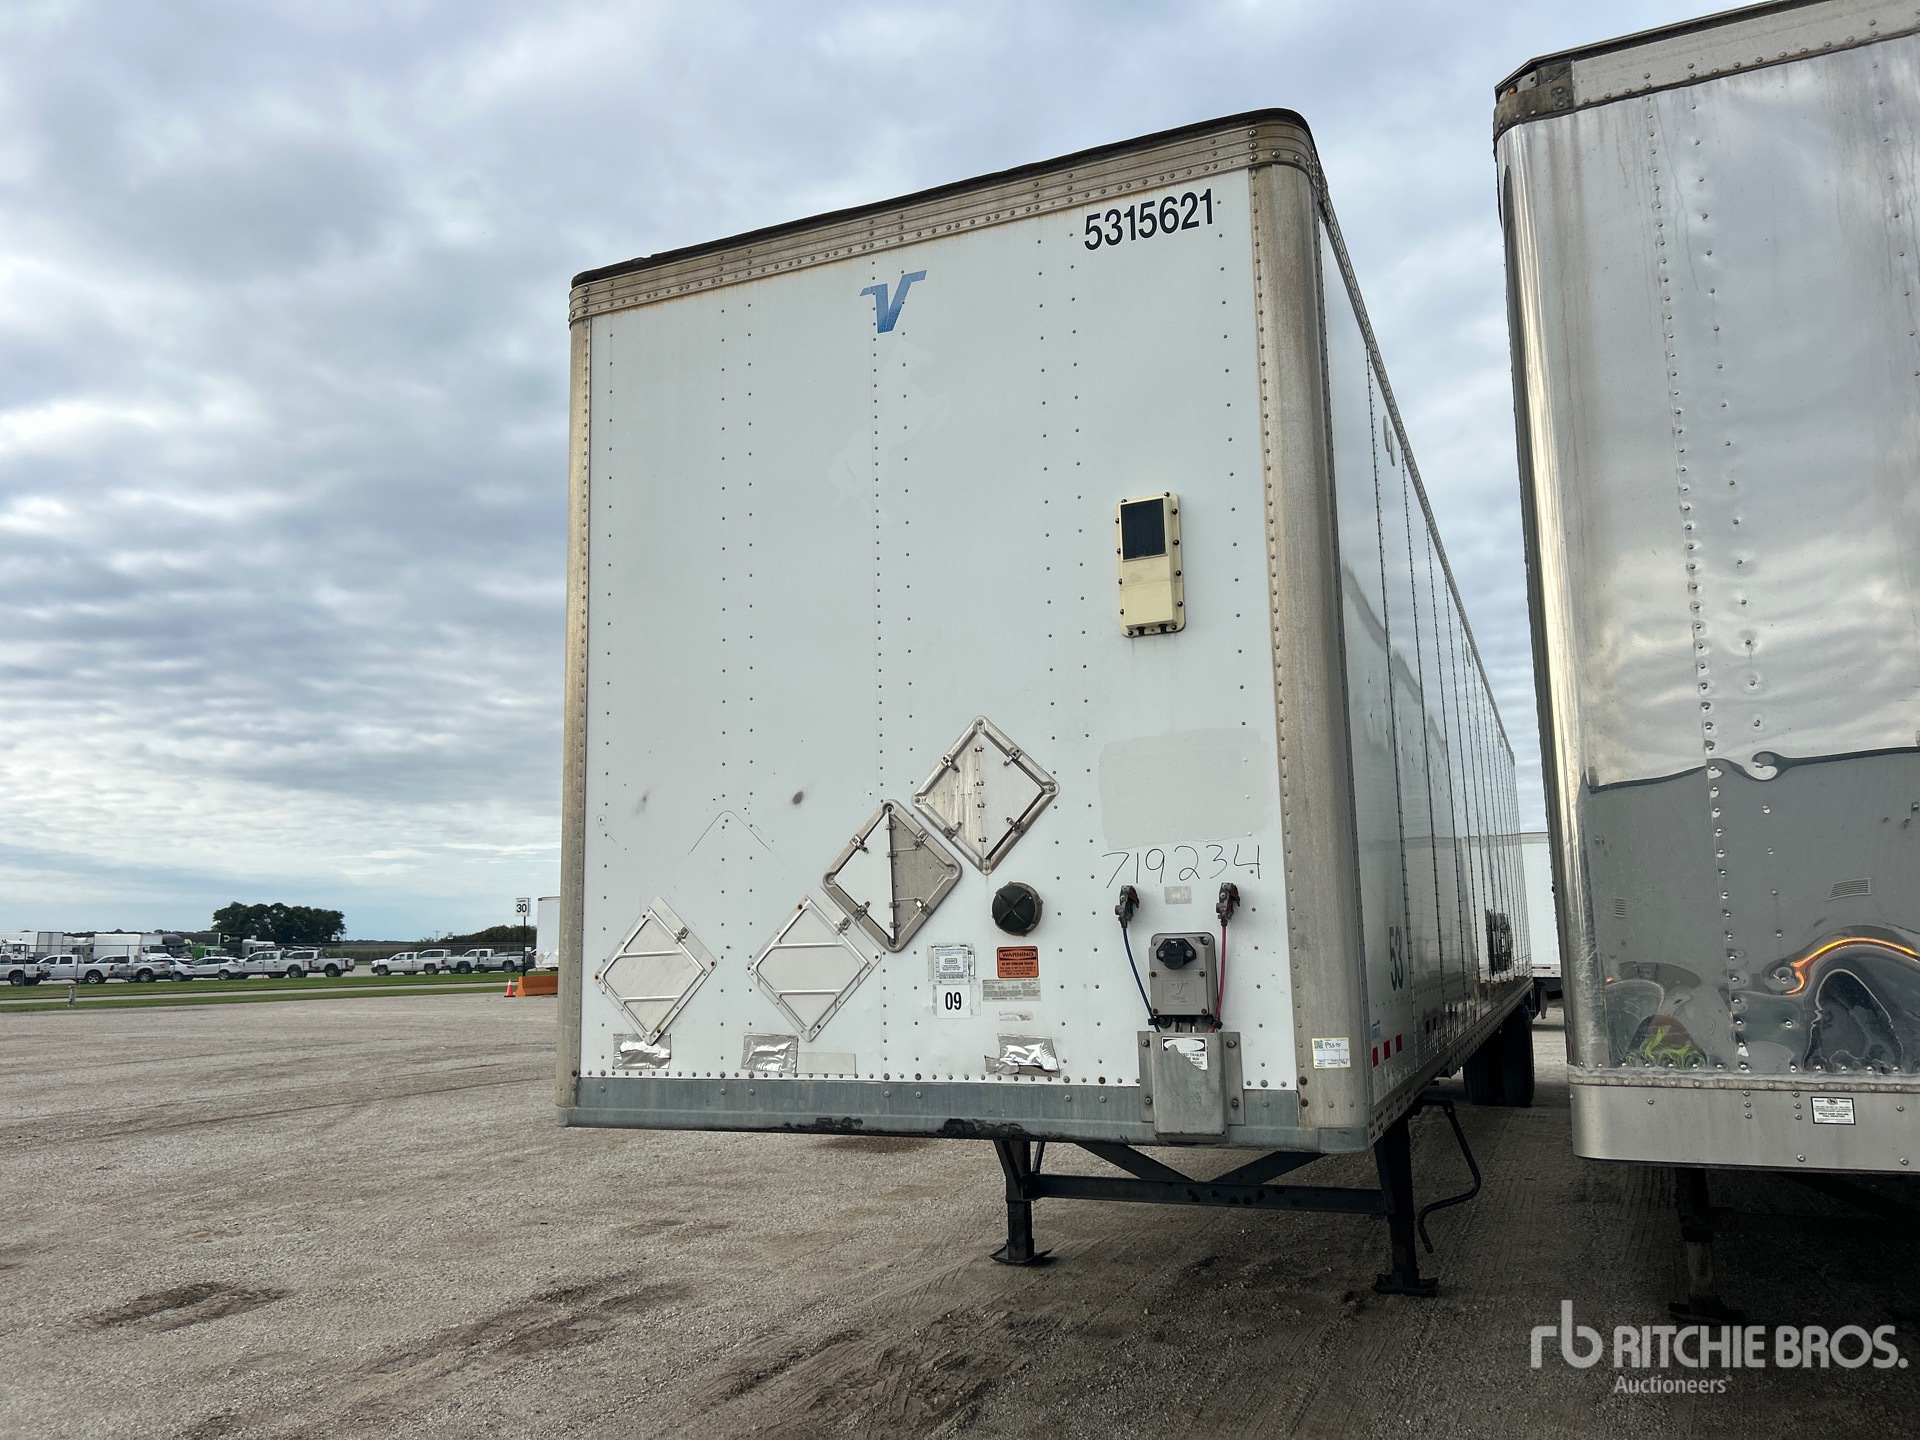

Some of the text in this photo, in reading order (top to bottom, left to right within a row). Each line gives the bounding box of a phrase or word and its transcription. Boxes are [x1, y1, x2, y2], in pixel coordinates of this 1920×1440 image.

[1084, 188, 1215, 250] 5315621
[1102, 844, 1261, 889] 719234
[516, 903, 527, 913] 30
[1389, 926, 1404, 991] 53
[945, 992, 962, 1010] 09
